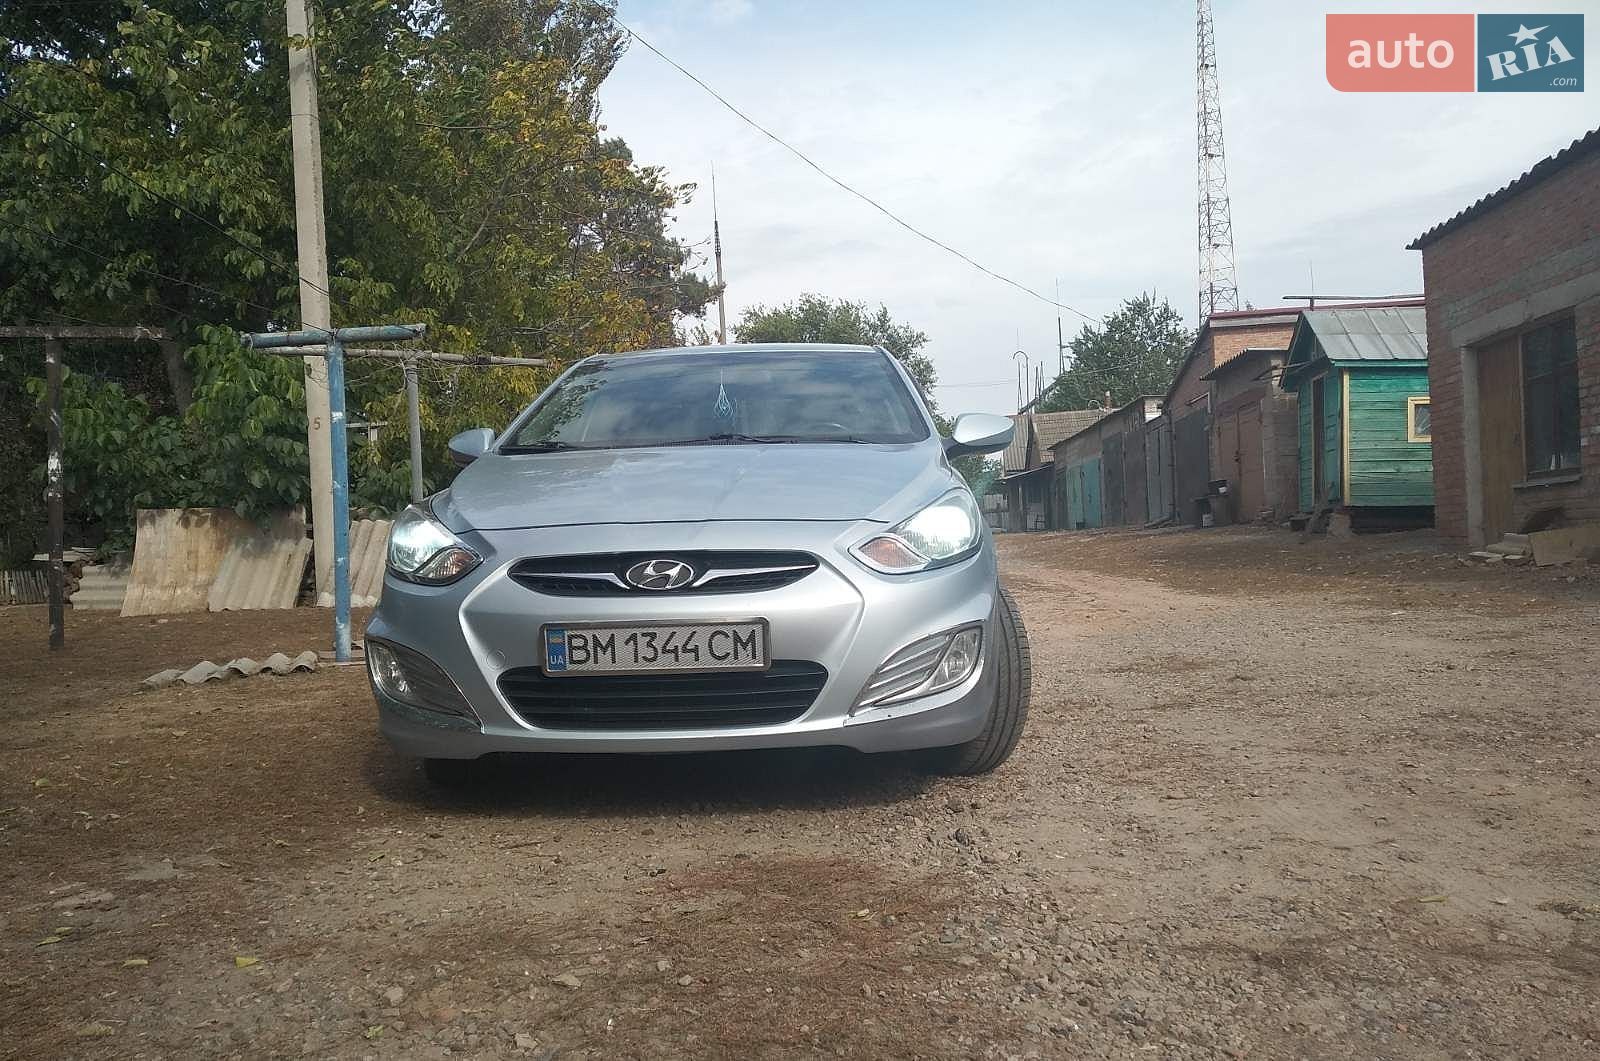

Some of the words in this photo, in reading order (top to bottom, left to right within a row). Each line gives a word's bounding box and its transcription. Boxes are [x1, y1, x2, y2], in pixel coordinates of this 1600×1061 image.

[567, 632, 617, 665] BM
[624, 630, 700, 664] 1344
[707, 629, 757, 662] CM
[550, 655, 564, 665] UA
